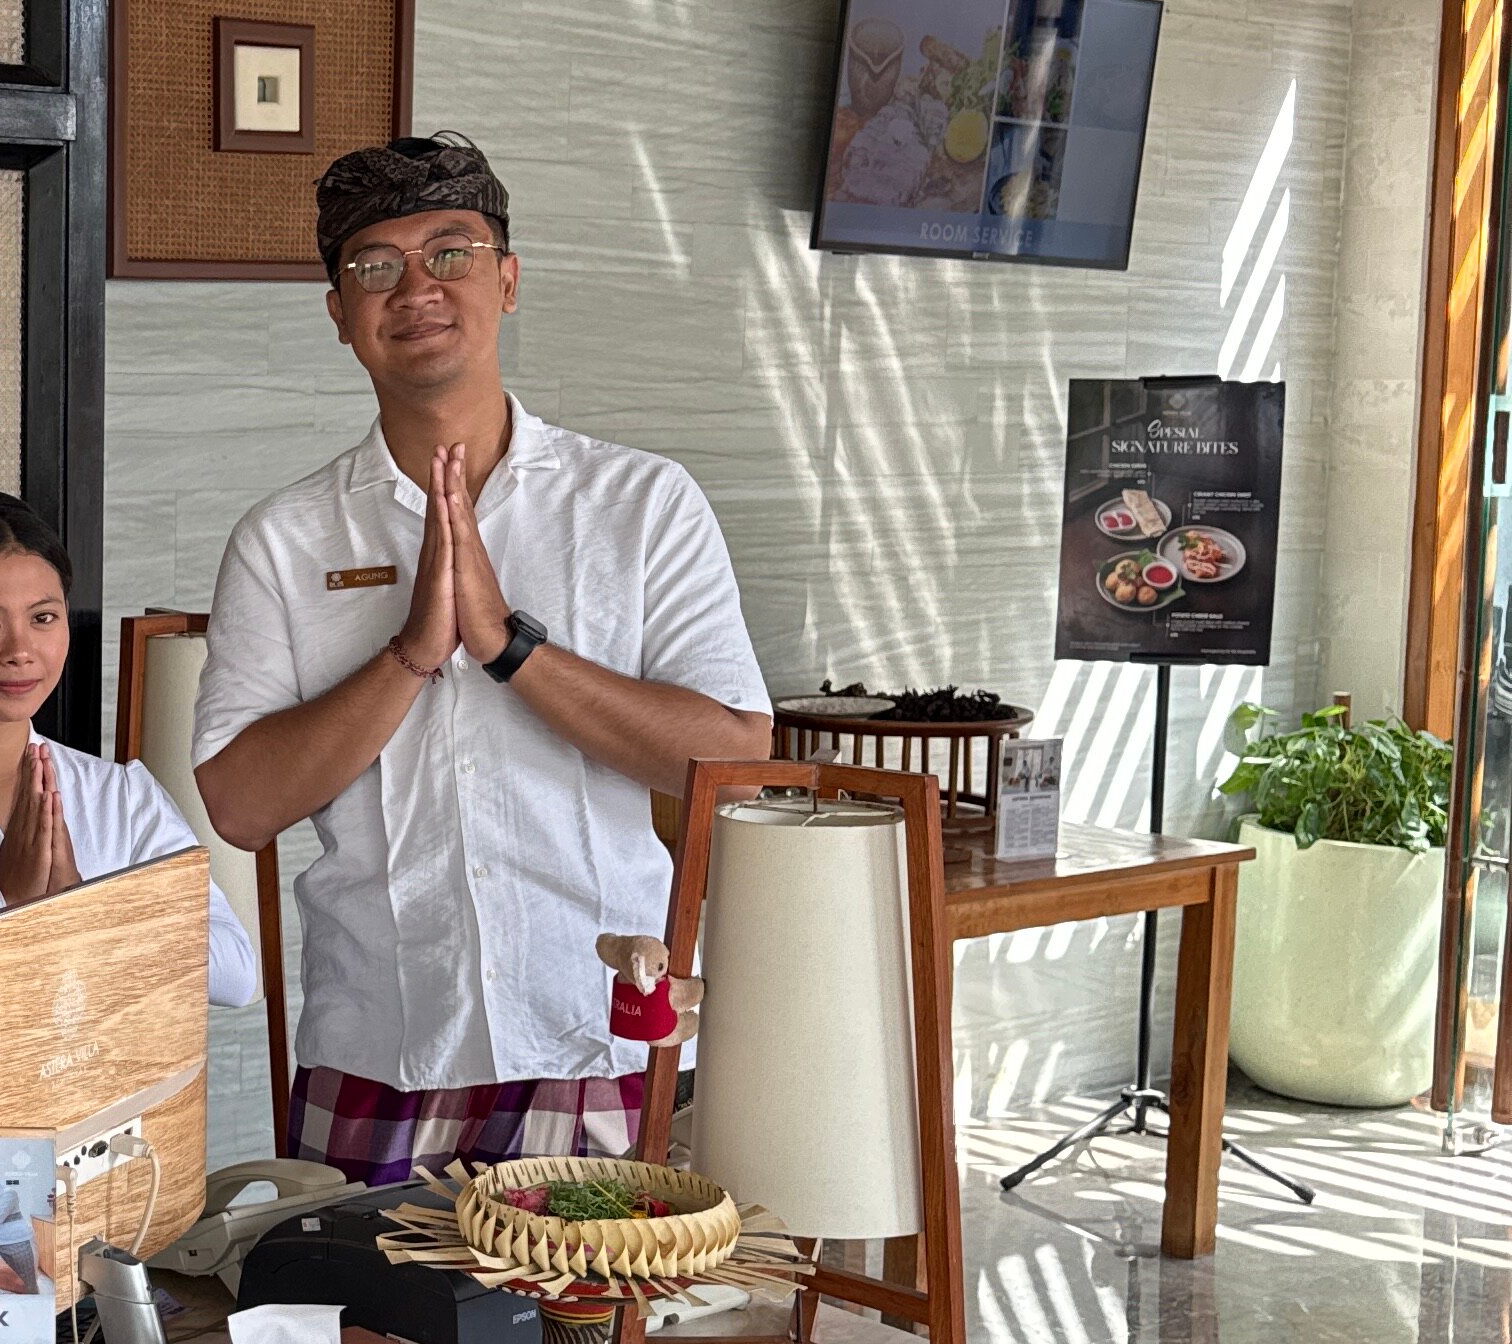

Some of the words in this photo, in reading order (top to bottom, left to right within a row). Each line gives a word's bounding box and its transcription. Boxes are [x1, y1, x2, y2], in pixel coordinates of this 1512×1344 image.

[919, 222, 967, 243] ROOM
[973, 226, 1033, 247] SERVICE
[1111, 440, 1193, 454] SIGNATURE
[1196, 441, 1239, 455] BITES
[354, 572, 388, 581] AGUNG
[513, 1309, 536, 1324] EPSON
